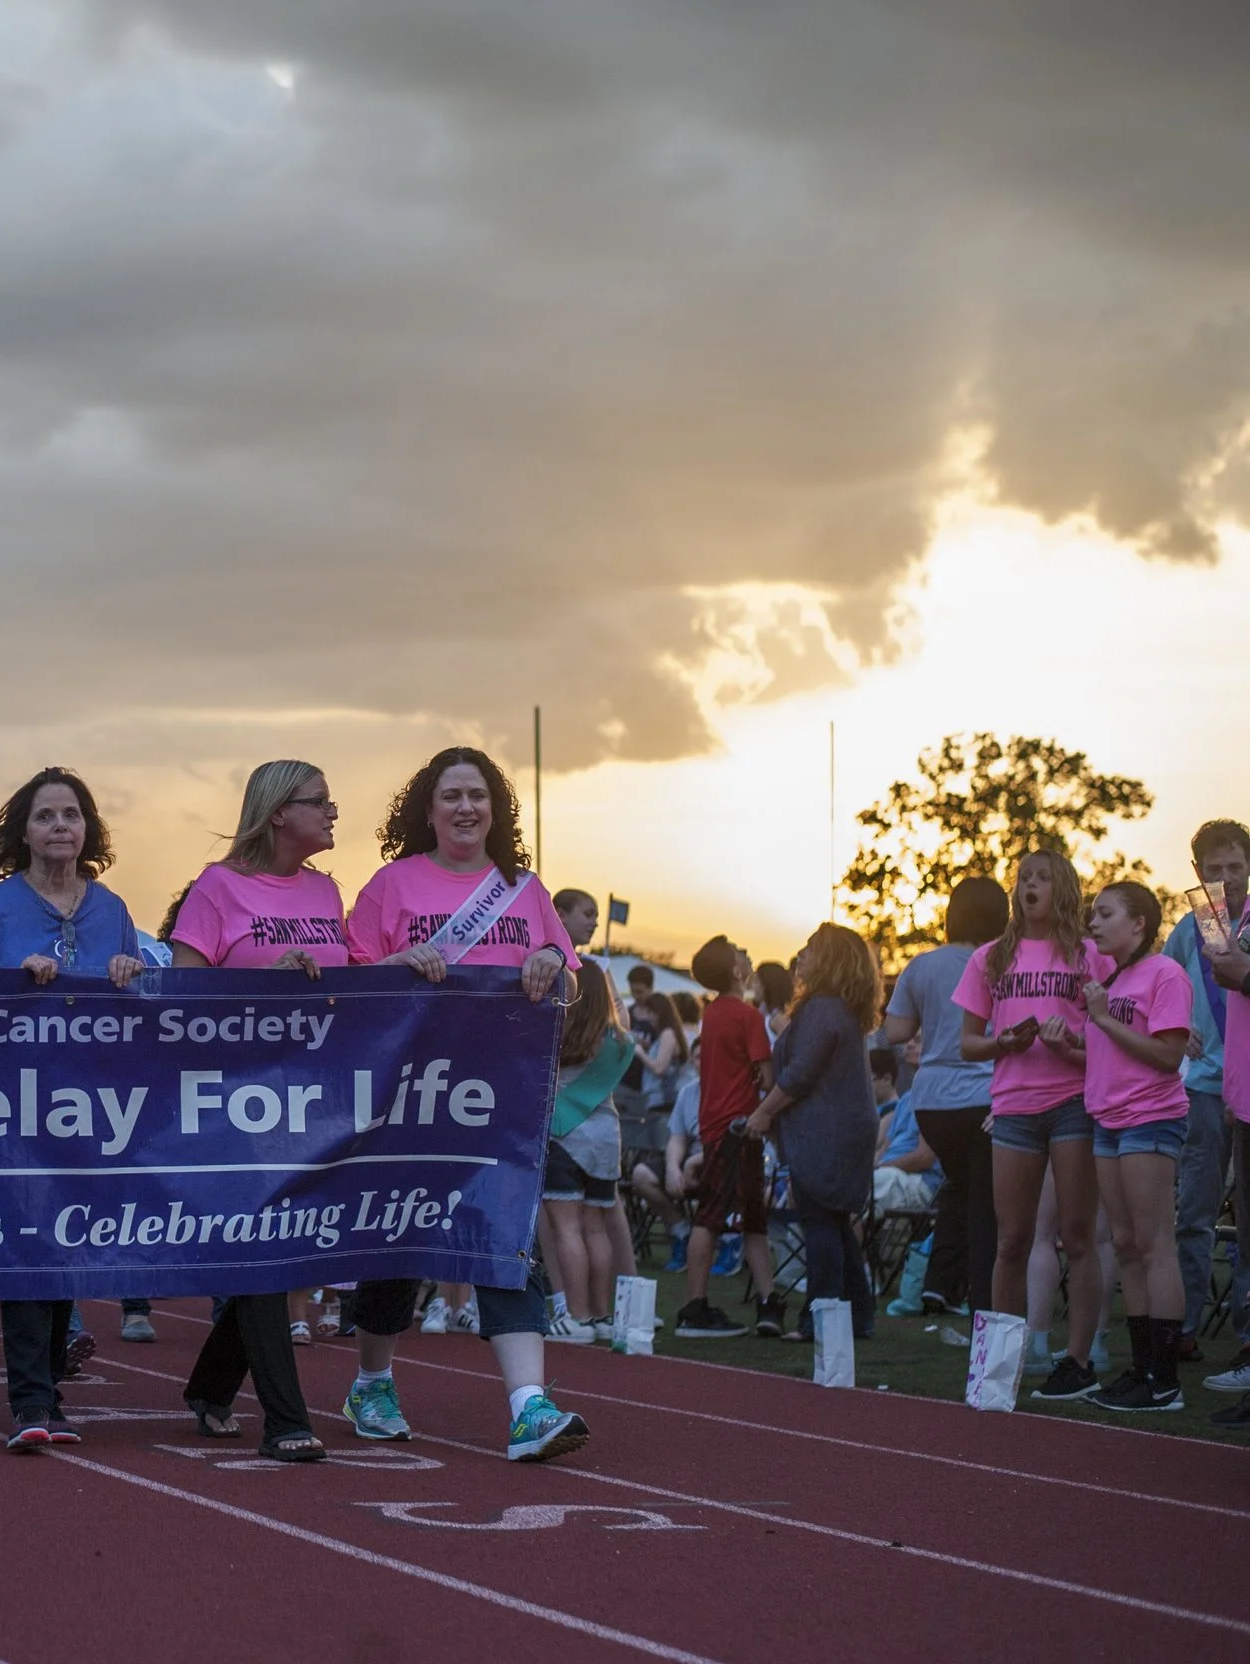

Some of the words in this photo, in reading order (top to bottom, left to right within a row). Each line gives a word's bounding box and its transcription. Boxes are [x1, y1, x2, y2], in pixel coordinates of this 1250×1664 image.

[452, 881, 506, 941] Survivor
[158, 1007, 335, 1050] Society
[180, 1070, 322, 1134] For
[354, 1058, 496, 1134] Life
[54, 1197, 346, 1249] Celebrating
[351, 1187, 463, 1243] Life!
